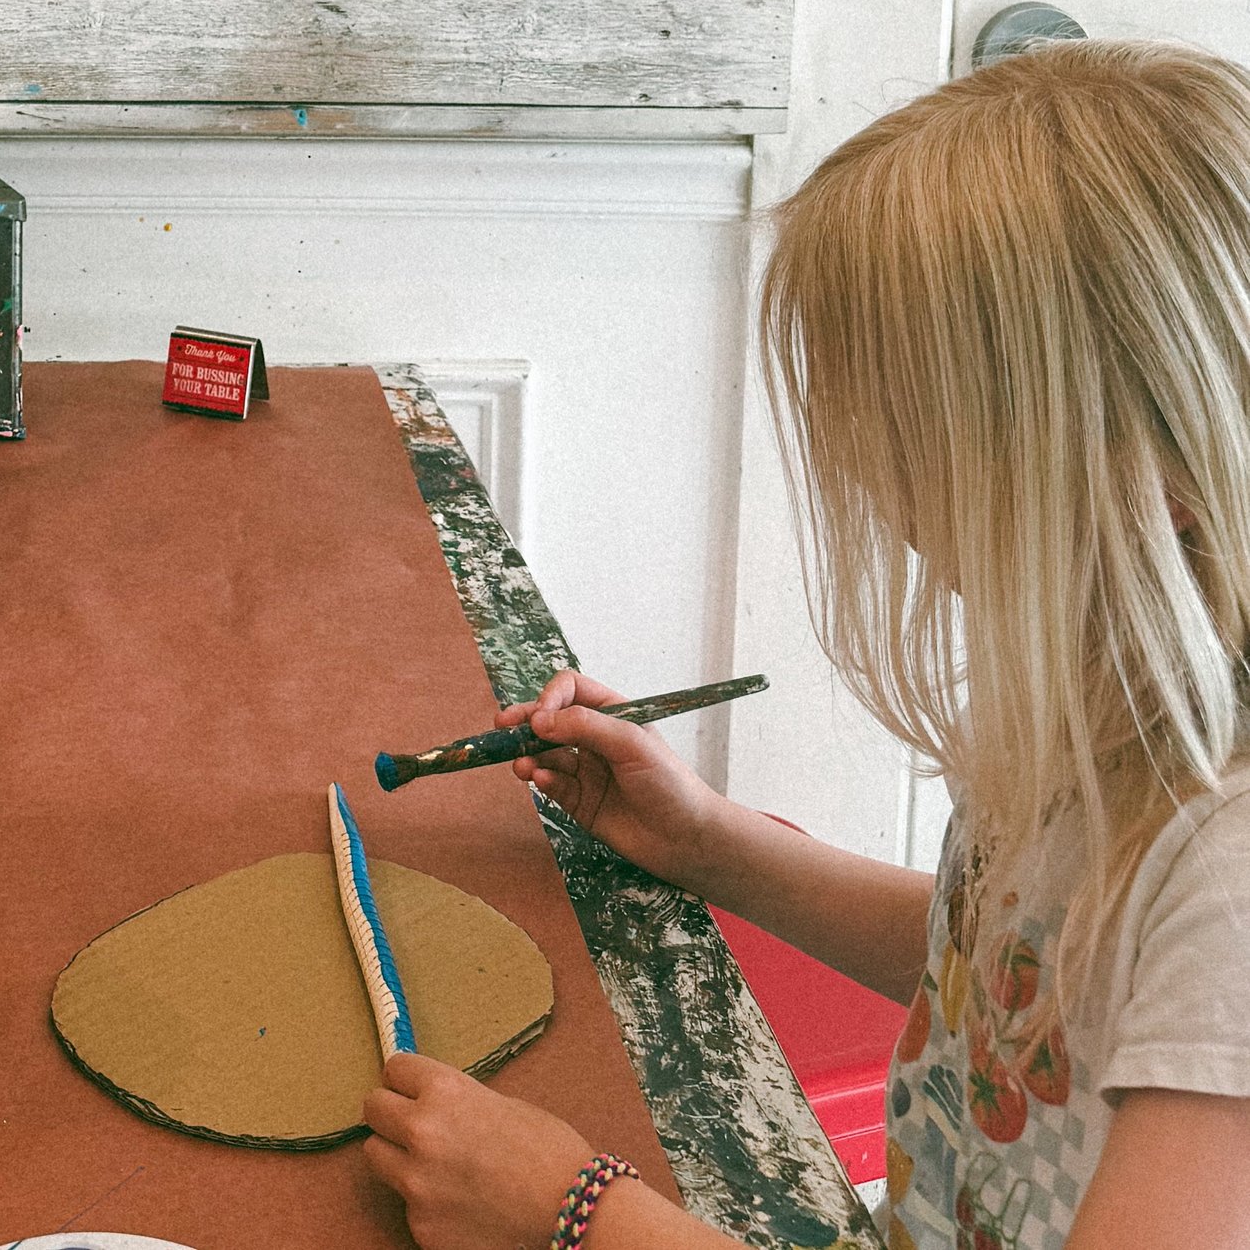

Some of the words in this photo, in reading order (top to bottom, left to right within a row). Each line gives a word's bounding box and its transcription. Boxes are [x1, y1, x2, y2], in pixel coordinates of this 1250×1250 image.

[184, 343, 214, 359] Thank
[216, 350, 236, 364] You
[172, 362, 194, 378] FOR
[197, 366, 244, 386] BUSSING
[173, 378, 201, 395] YOUR
[204, 383, 240, 401] TABLE
